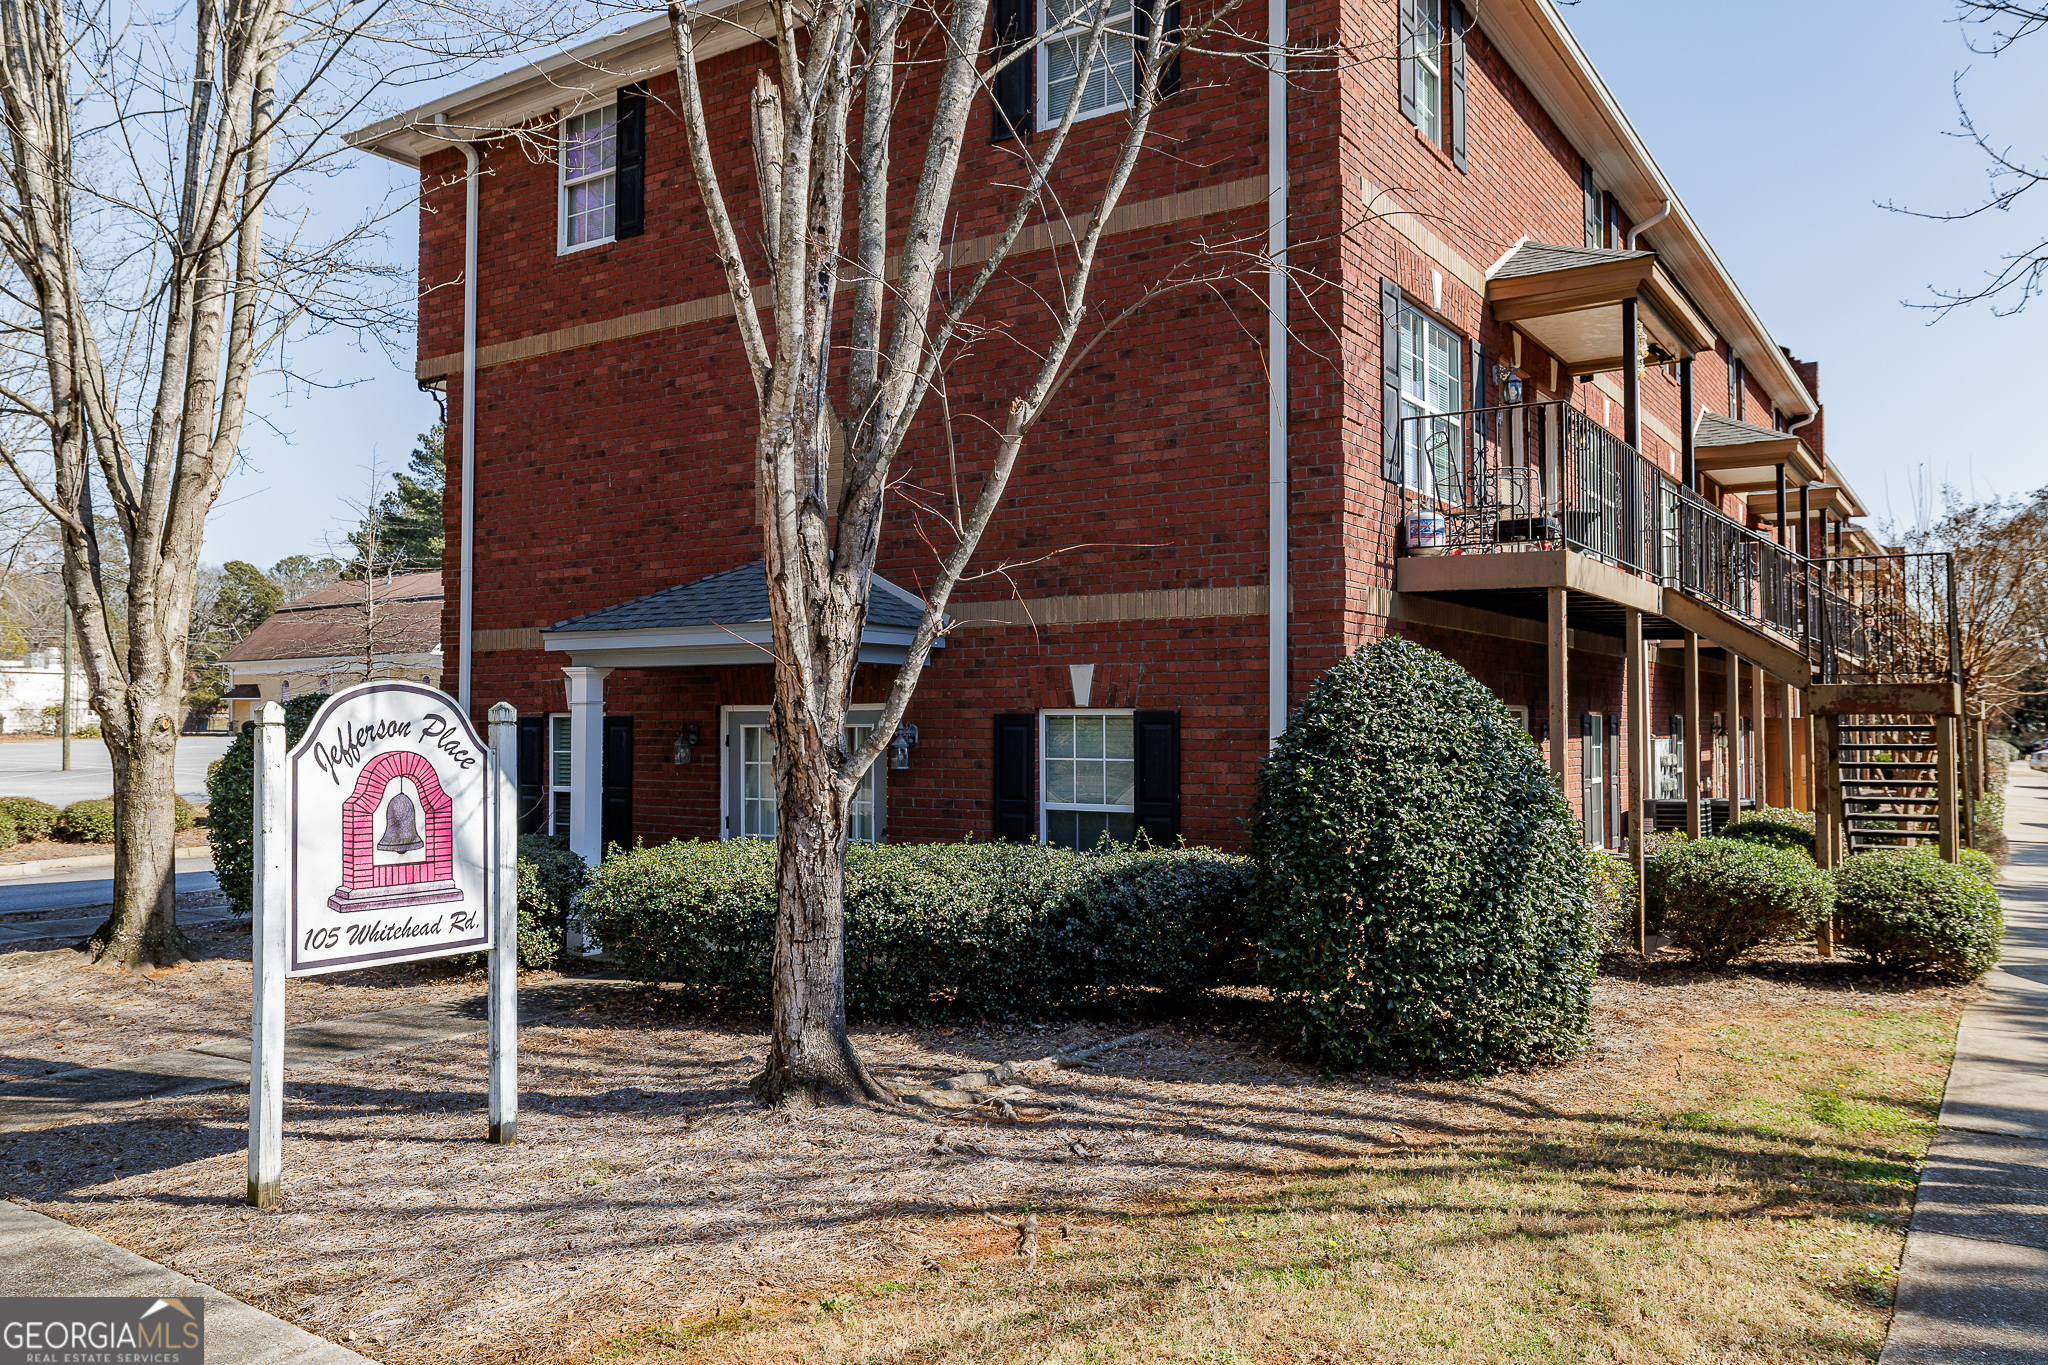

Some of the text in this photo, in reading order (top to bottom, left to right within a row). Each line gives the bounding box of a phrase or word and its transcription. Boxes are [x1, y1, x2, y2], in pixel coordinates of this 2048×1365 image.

[313, 713, 476, 785] Jefferson Place
[304, 910, 480, 951] 105 Whitehead Rd.
